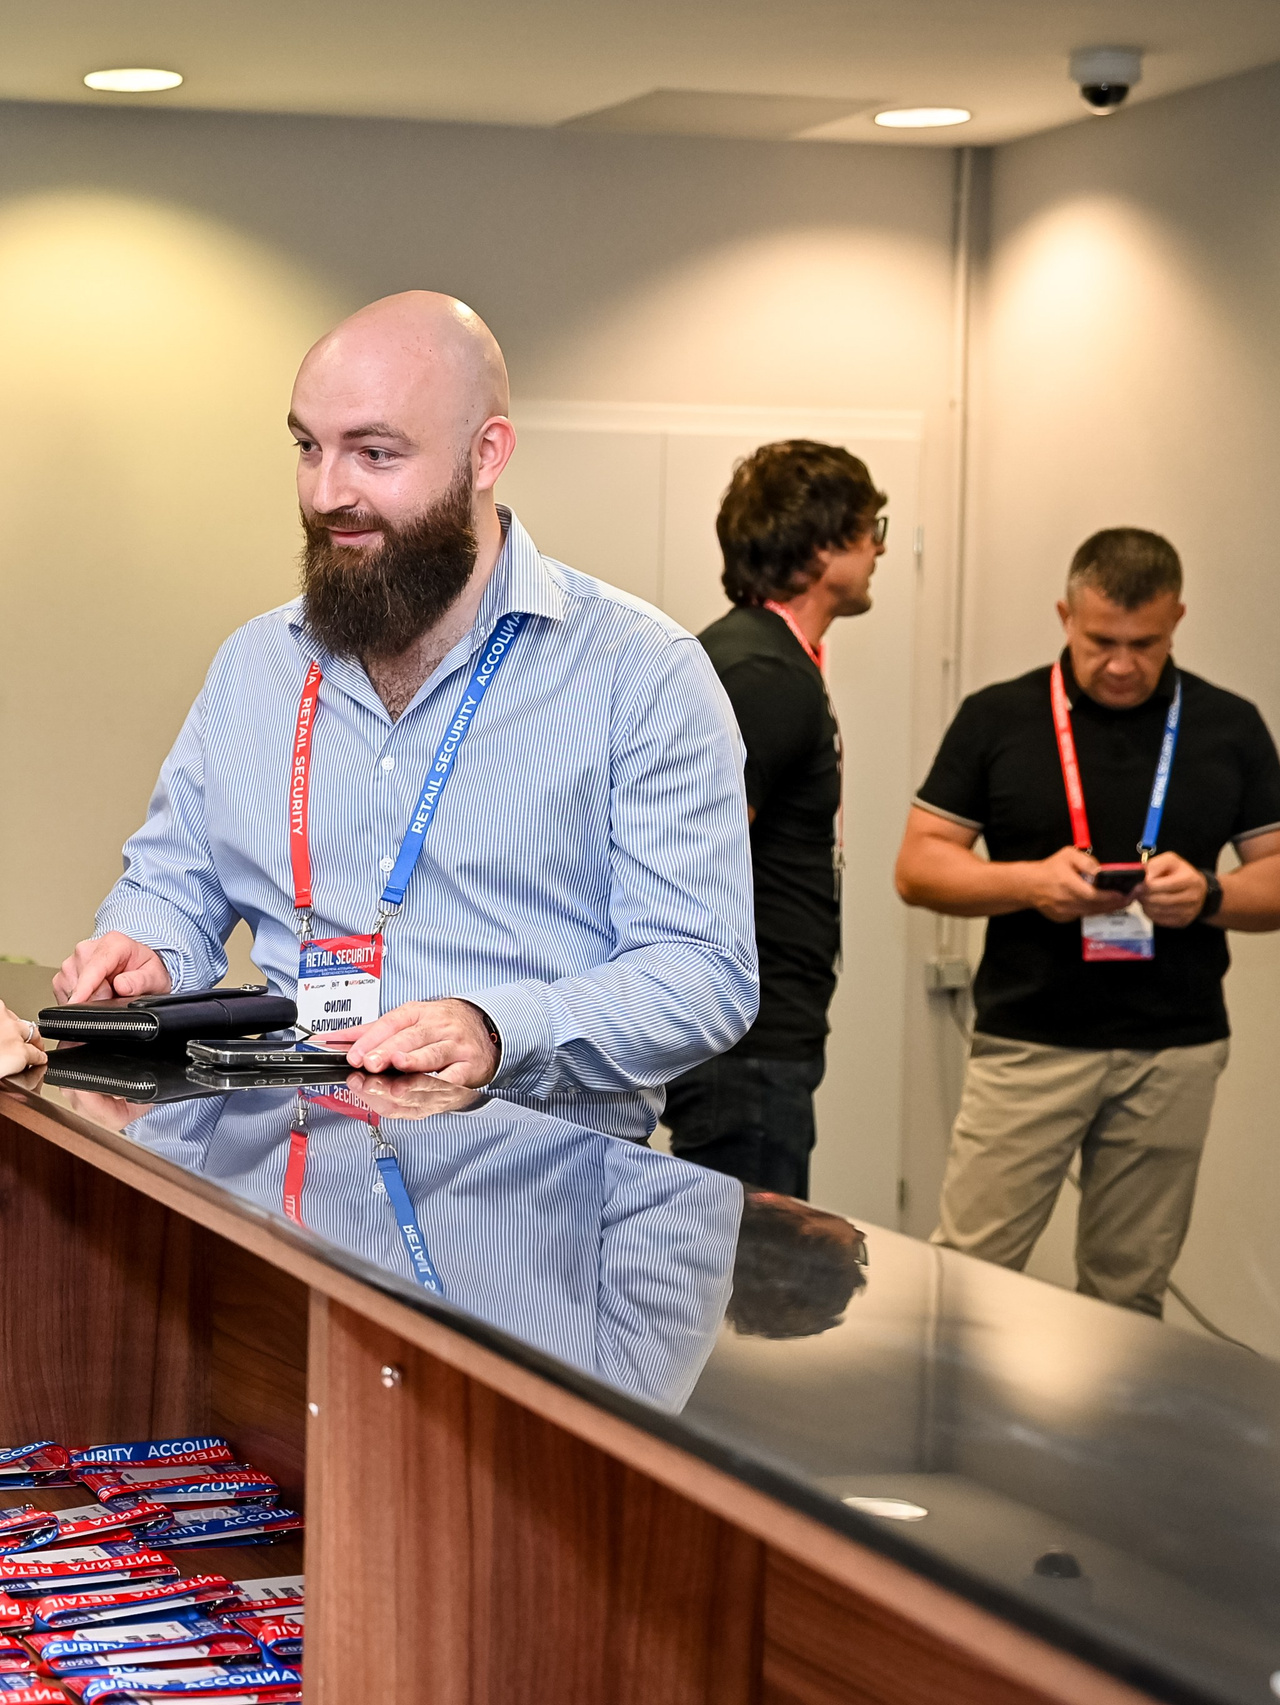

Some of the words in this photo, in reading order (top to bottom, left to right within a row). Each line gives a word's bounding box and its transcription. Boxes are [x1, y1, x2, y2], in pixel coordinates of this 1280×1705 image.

[296, 697, 312, 753] RETAIL
[411, 777, 443, 834] RETAIL
[435, 695, 477, 773] SECURITY
[292, 755, 306, 836] SECURITY
[306, 951, 334, 968] RETAIL
[336, 946, 376, 965] SECURITY
[324, 999, 352, 1013] ФИЛИП
[158, 1448, 231, 1465] ИТЕЙЛА
[200, 1473, 273, 1482] ИТЕЙЛА
[89, 1504, 167, 1526] ИТЕЙЛА
[68, 1554, 163, 1573] РИТЕЙЛА
[130, 1575, 227, 1598] РИТЕЙЛА
[45, 1595, 116, 1608] RETAIL
[185, 1669, 298, 1689] АССОЦИА
